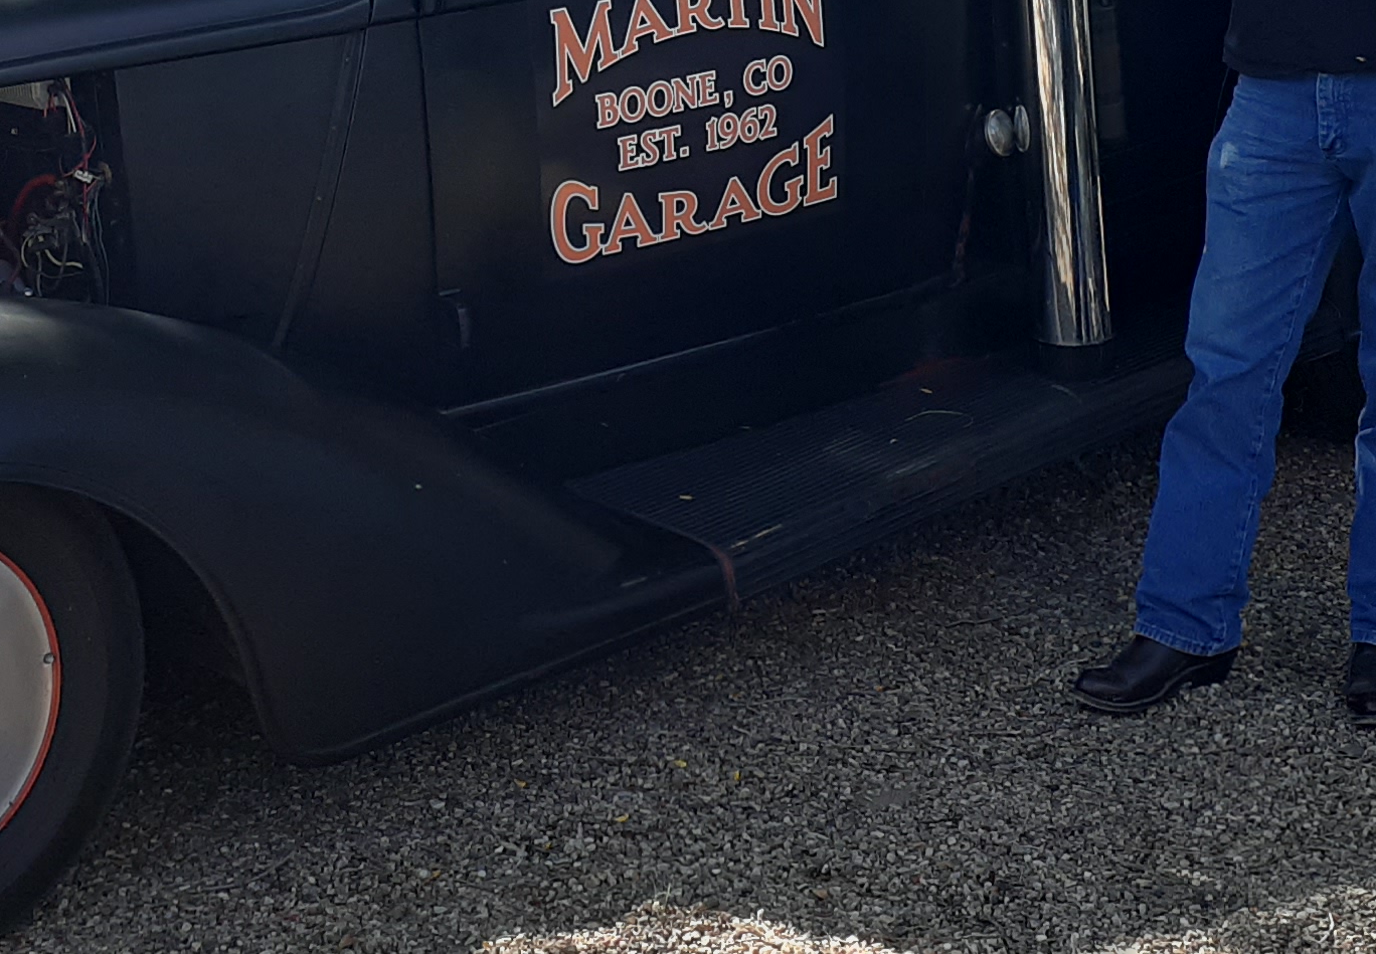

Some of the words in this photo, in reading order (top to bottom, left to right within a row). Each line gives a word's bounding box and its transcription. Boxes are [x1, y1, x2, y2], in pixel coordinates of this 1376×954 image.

[595, 70, 733, 129] BOONE,
[743, 54, 793, 96] CO
[618, 124, 690, 171] EST.
[706, 103, 777, 151] 1962
[550, 113, 837, 264] GARAGE
